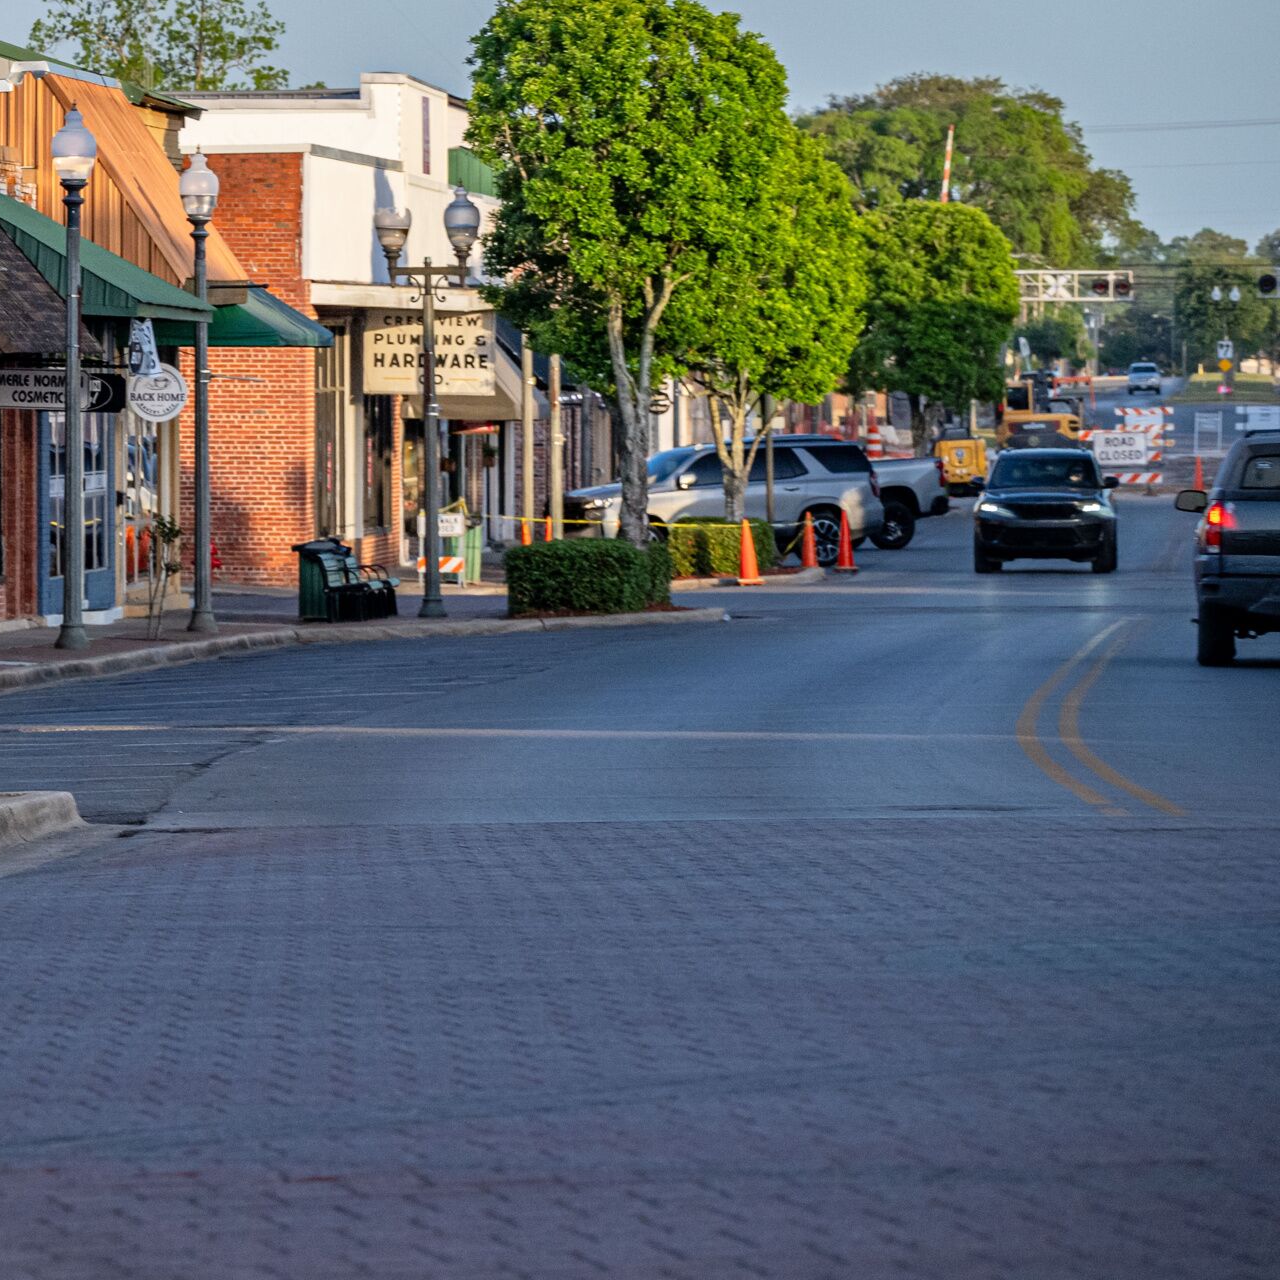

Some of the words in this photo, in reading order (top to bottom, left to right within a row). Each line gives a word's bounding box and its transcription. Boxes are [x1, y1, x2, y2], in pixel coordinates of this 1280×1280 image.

[383, 315, 481, 327] CRESVIEW
[373, 333, 465, 346] PLUMING
[475, 335, 487, 346] &
[33, 375, 85, 388] NORM
[11, 390, 67, 404] COSMETIC
[129, 392, 155, 402] BACK
[157, 392, 185, 402] HOME
[1104, 437, 1136, 447] ROAD
[1098, 450, 1143, 461] CLOSED
